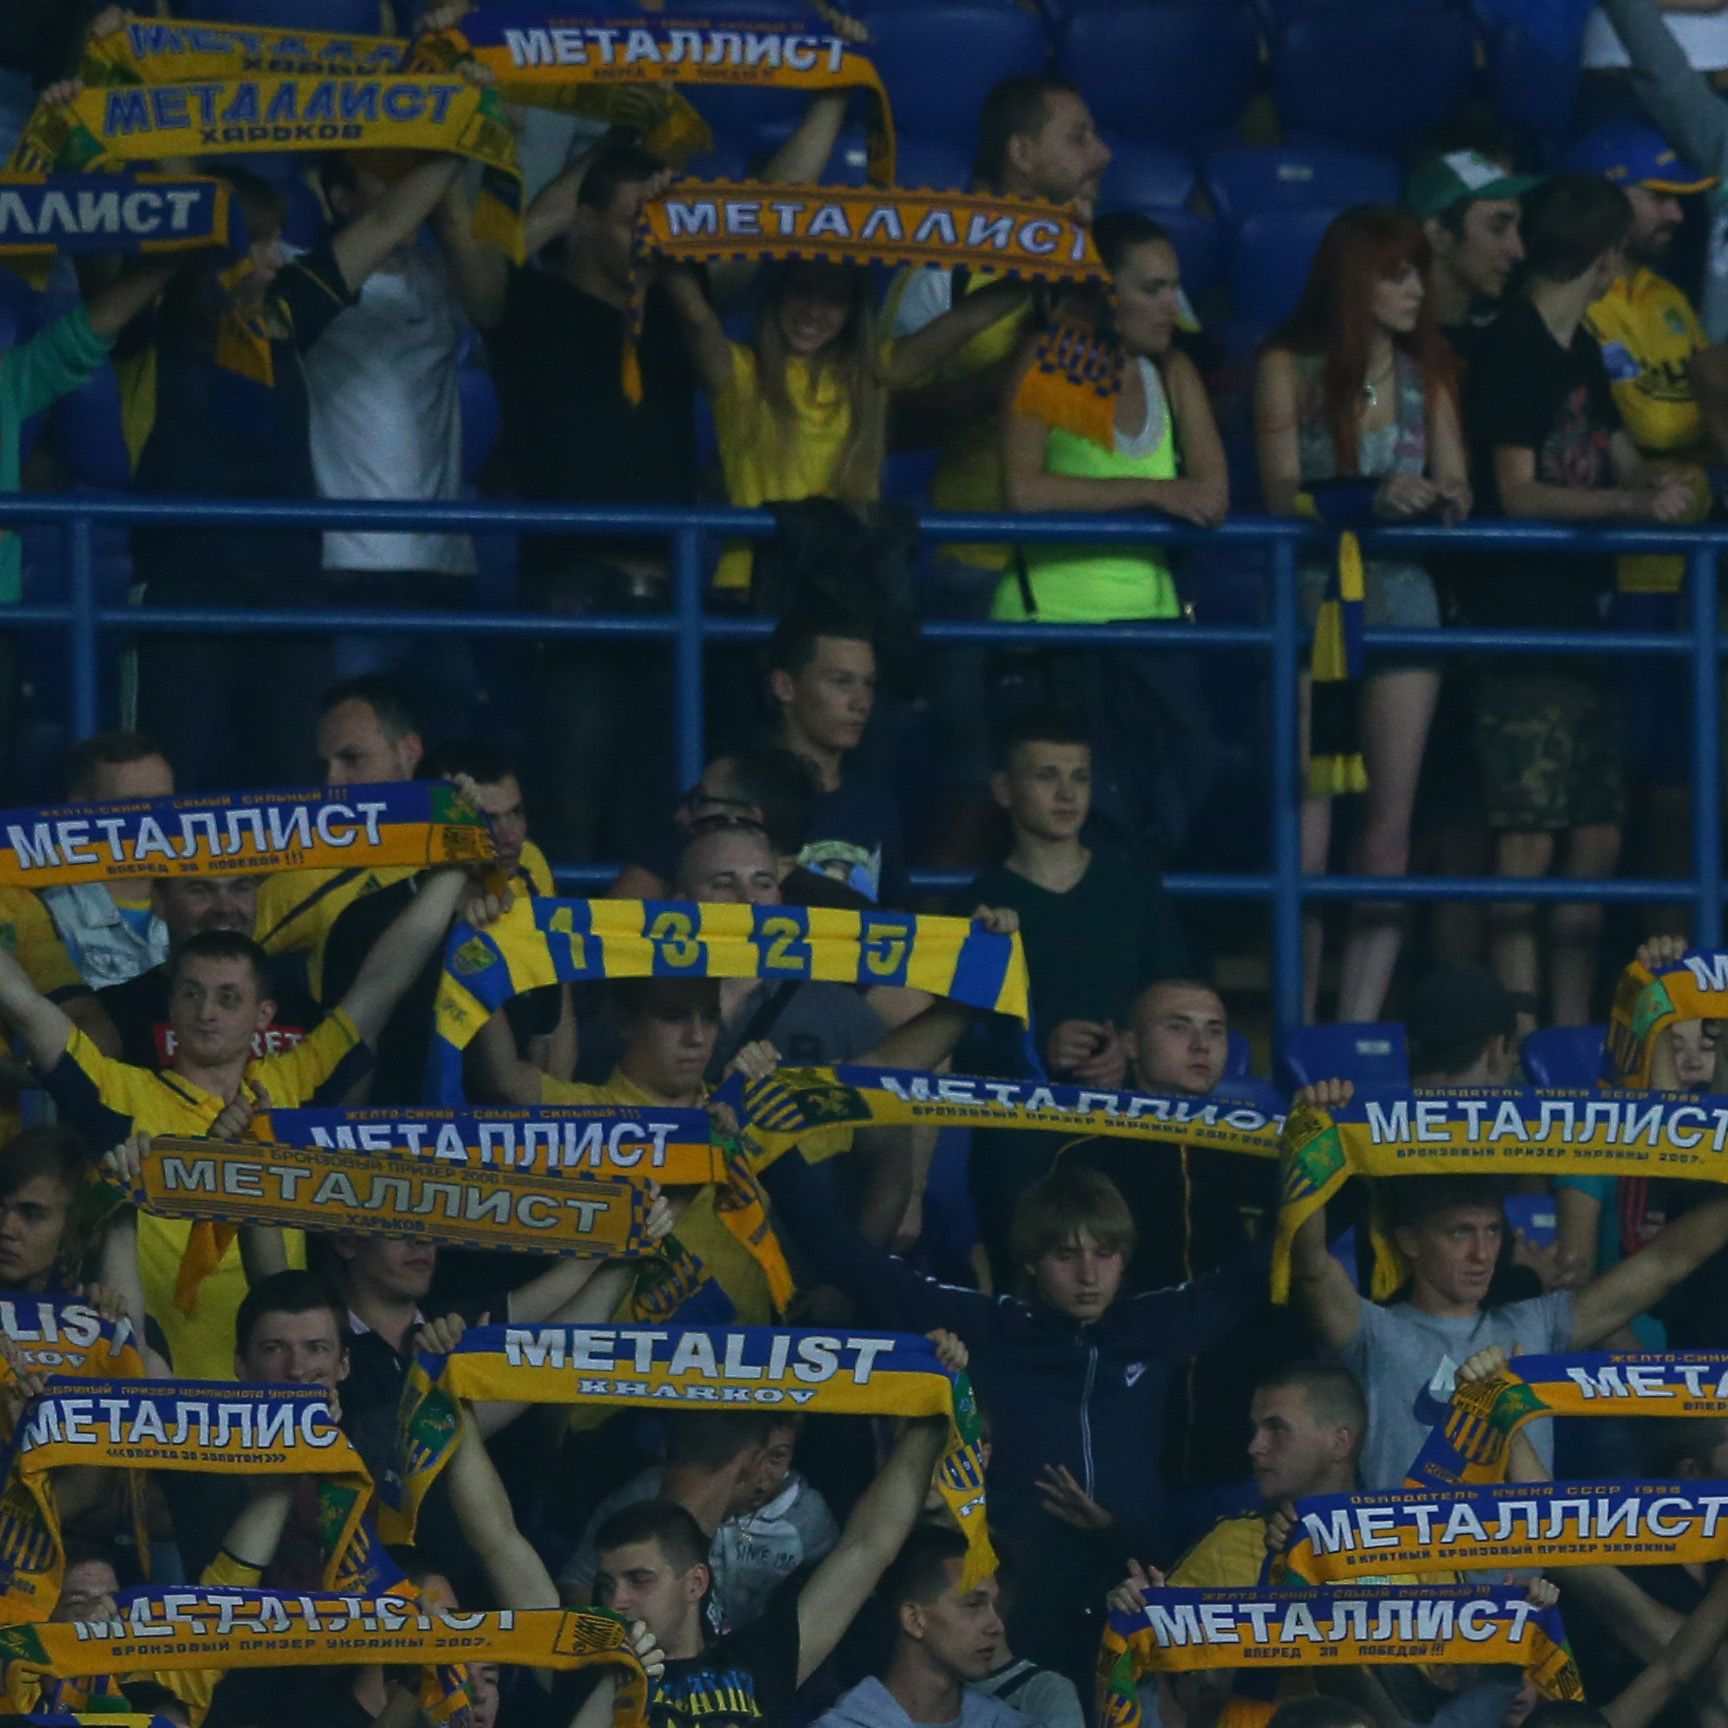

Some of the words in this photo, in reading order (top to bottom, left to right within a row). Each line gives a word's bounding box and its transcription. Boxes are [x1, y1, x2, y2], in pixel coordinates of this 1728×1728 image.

[6, 801, 389, 872] МЕТАЛЛИСТ
[163, 1156, 608, 1236] МЕТАЛЛИСТ
[503, 1330, 896, 1385] METALIST
[577, 1377, 817, 1406] KHARKOV
[239, 1637, 318, 1651] ПРИЗЕР
[1144, 1599, 1546, 1649] МЕТАЛЛИСТ
